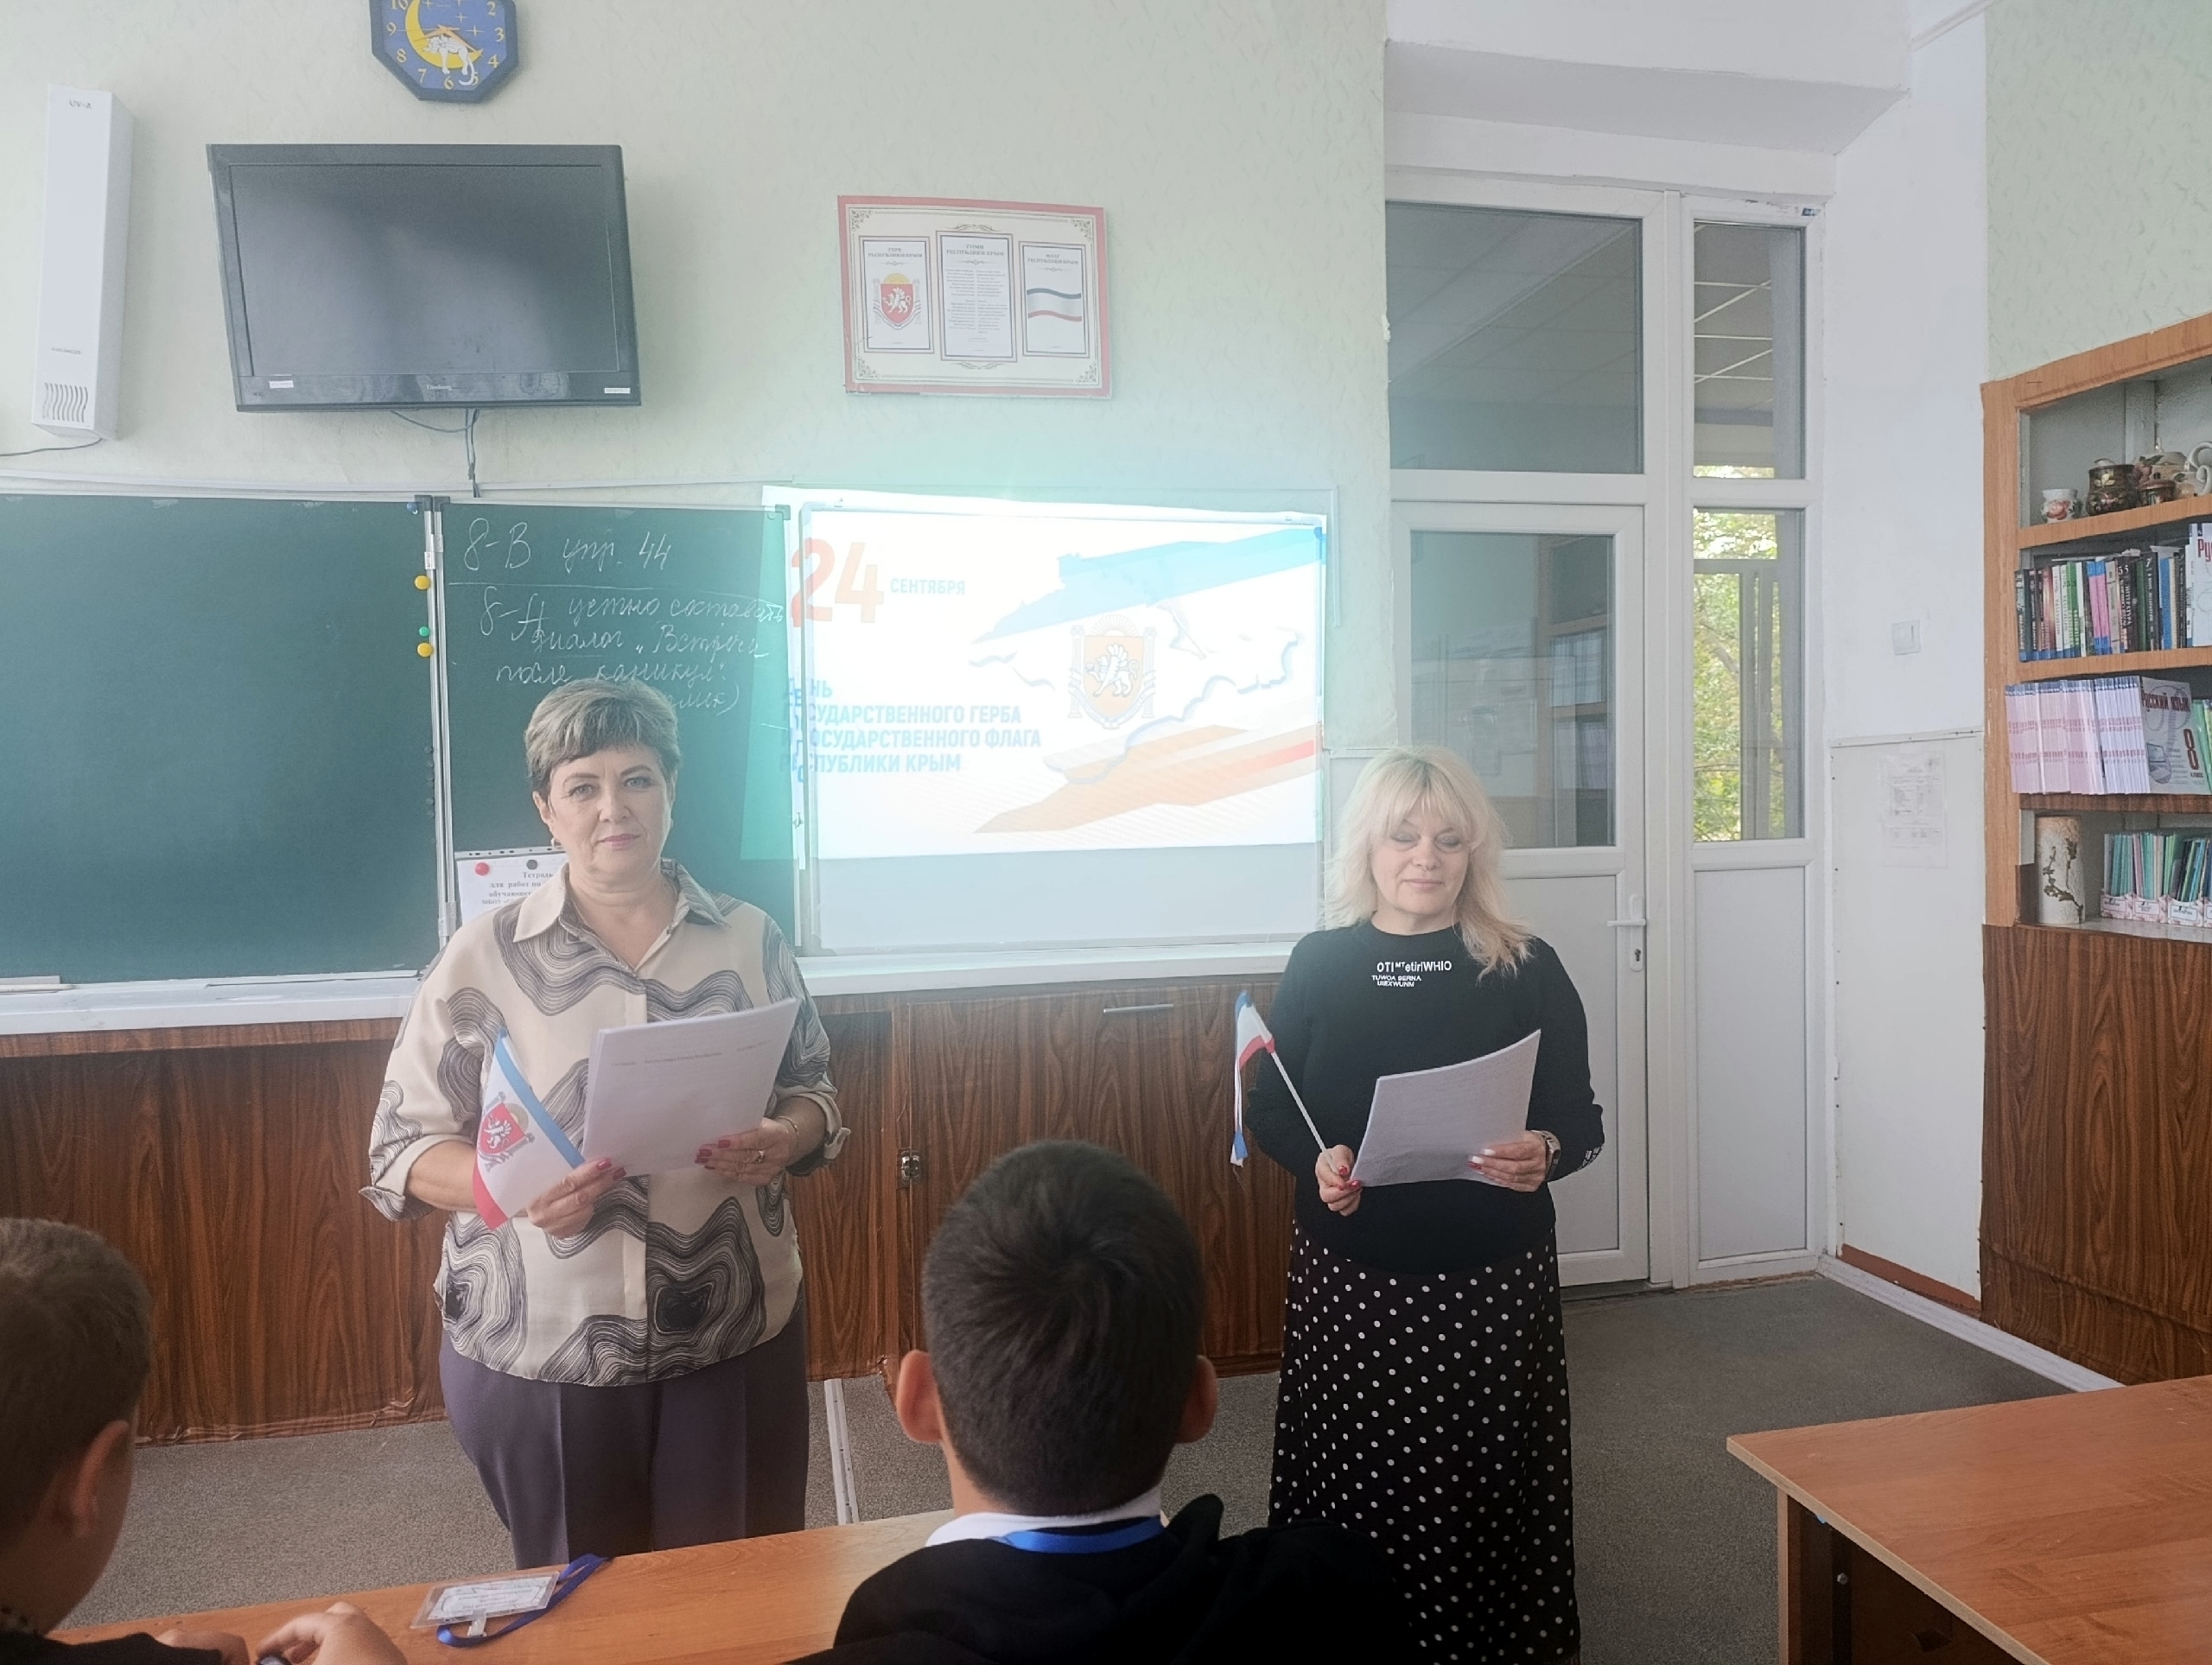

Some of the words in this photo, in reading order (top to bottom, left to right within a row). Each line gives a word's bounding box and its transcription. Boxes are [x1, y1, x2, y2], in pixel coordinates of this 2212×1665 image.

[486, 2, 496, 16] 2
[386, 22, 397, 36] 9
[494, 27, 505, 41] 3
[397, 48, 407, 63] 8
[487, 54, 499, 68] 4
[417, 68, 427, 83] 7
[444, 75, 454, 90] 6
[639, 531, 671, 570] 44
[2197, 538, 2212, 562] Ру
[790, 537, 884, 628] 24
[890, 577, 966, 596] СЕНТЯБРЯ
[496, 662, 574, 685] после
[969, 705, 1022, 724] ГЕРБА
[985, 728, 1041, 748] ФЛАГА
[2183, 728, 2200, 771] 8
[906, 753, 961, 772] КРЫМ
